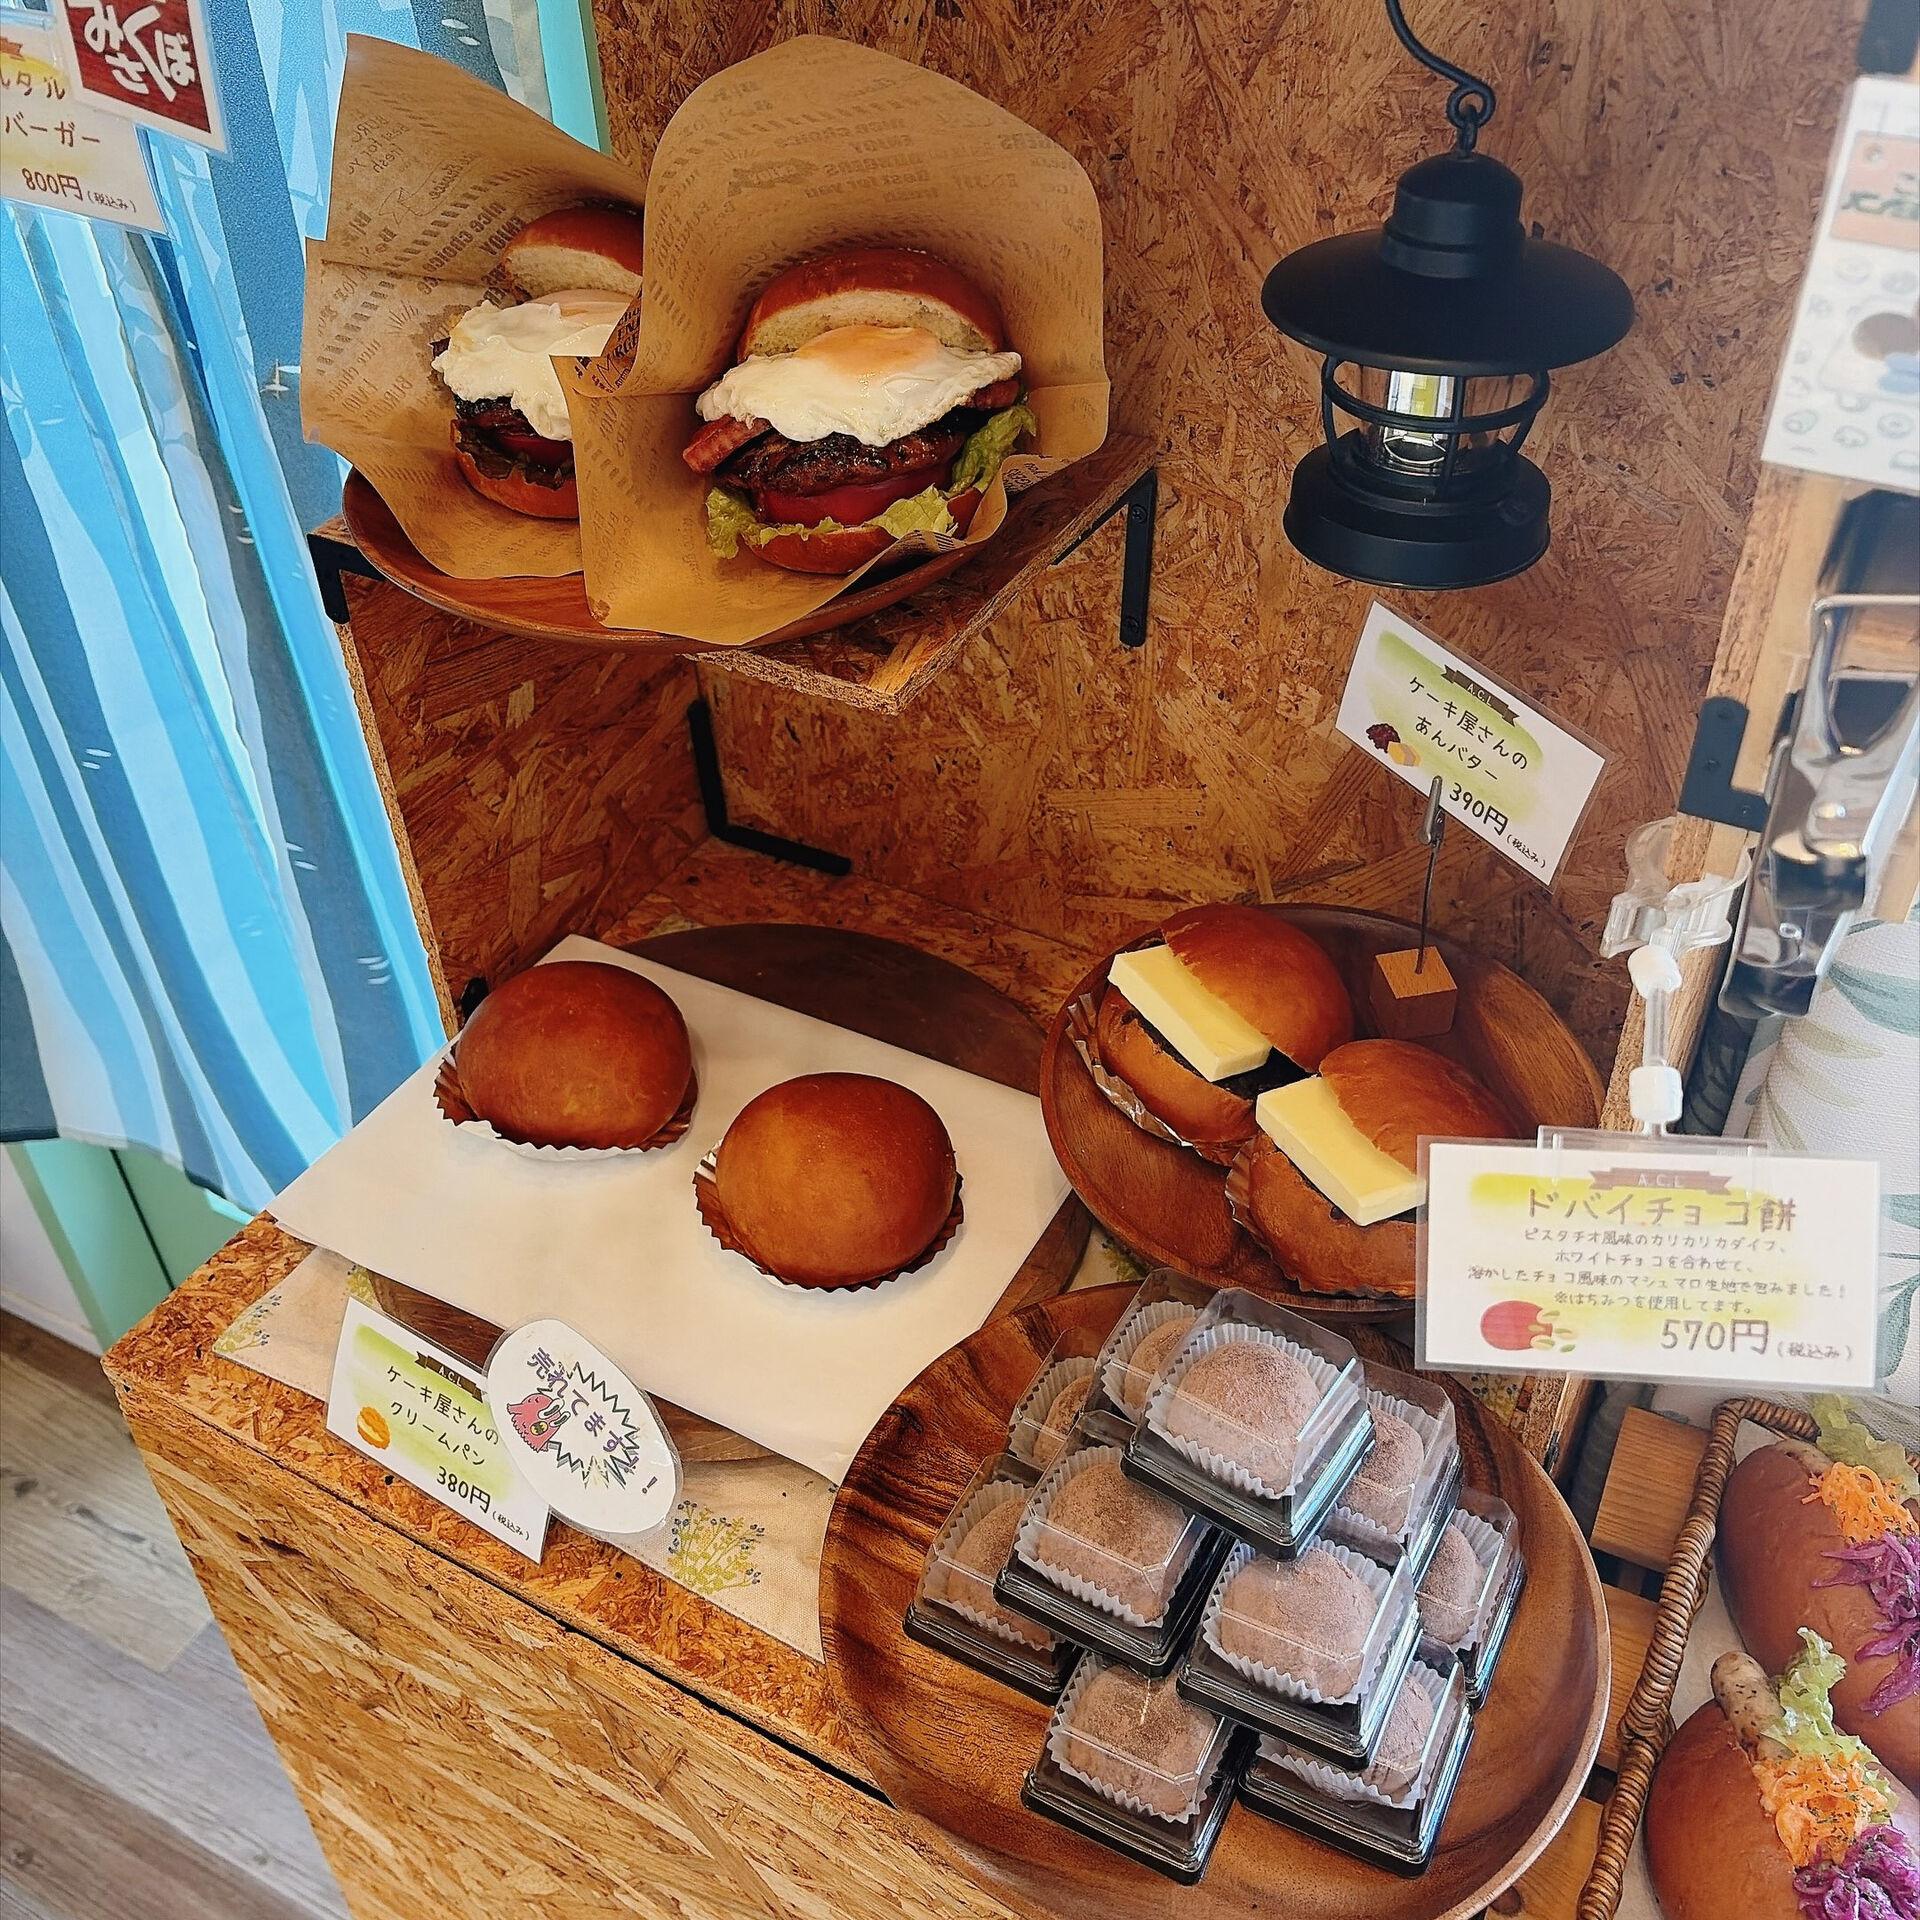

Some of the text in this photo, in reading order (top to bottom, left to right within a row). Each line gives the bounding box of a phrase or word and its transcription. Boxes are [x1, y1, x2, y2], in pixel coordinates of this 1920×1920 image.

[5, 112, 100, 148] バーガー
[22, 168, 83, 201] 800円
[1409, 676, 1528, 770] ケーキ屋さんの
[1415, 715, 1498, 781] あんバター
[1450, 782, 1508, 836] 390円
[1528, 1187, 1797, 1233] ドバイチョコ餅
[1660, 1318, 1770, 1355] 570円
[387, 1365, 500, 1446] ケーキ屋さんの
[390, 1401, 486, 1466] クリームパン
[436, 1466, 492, 1514] 380円
